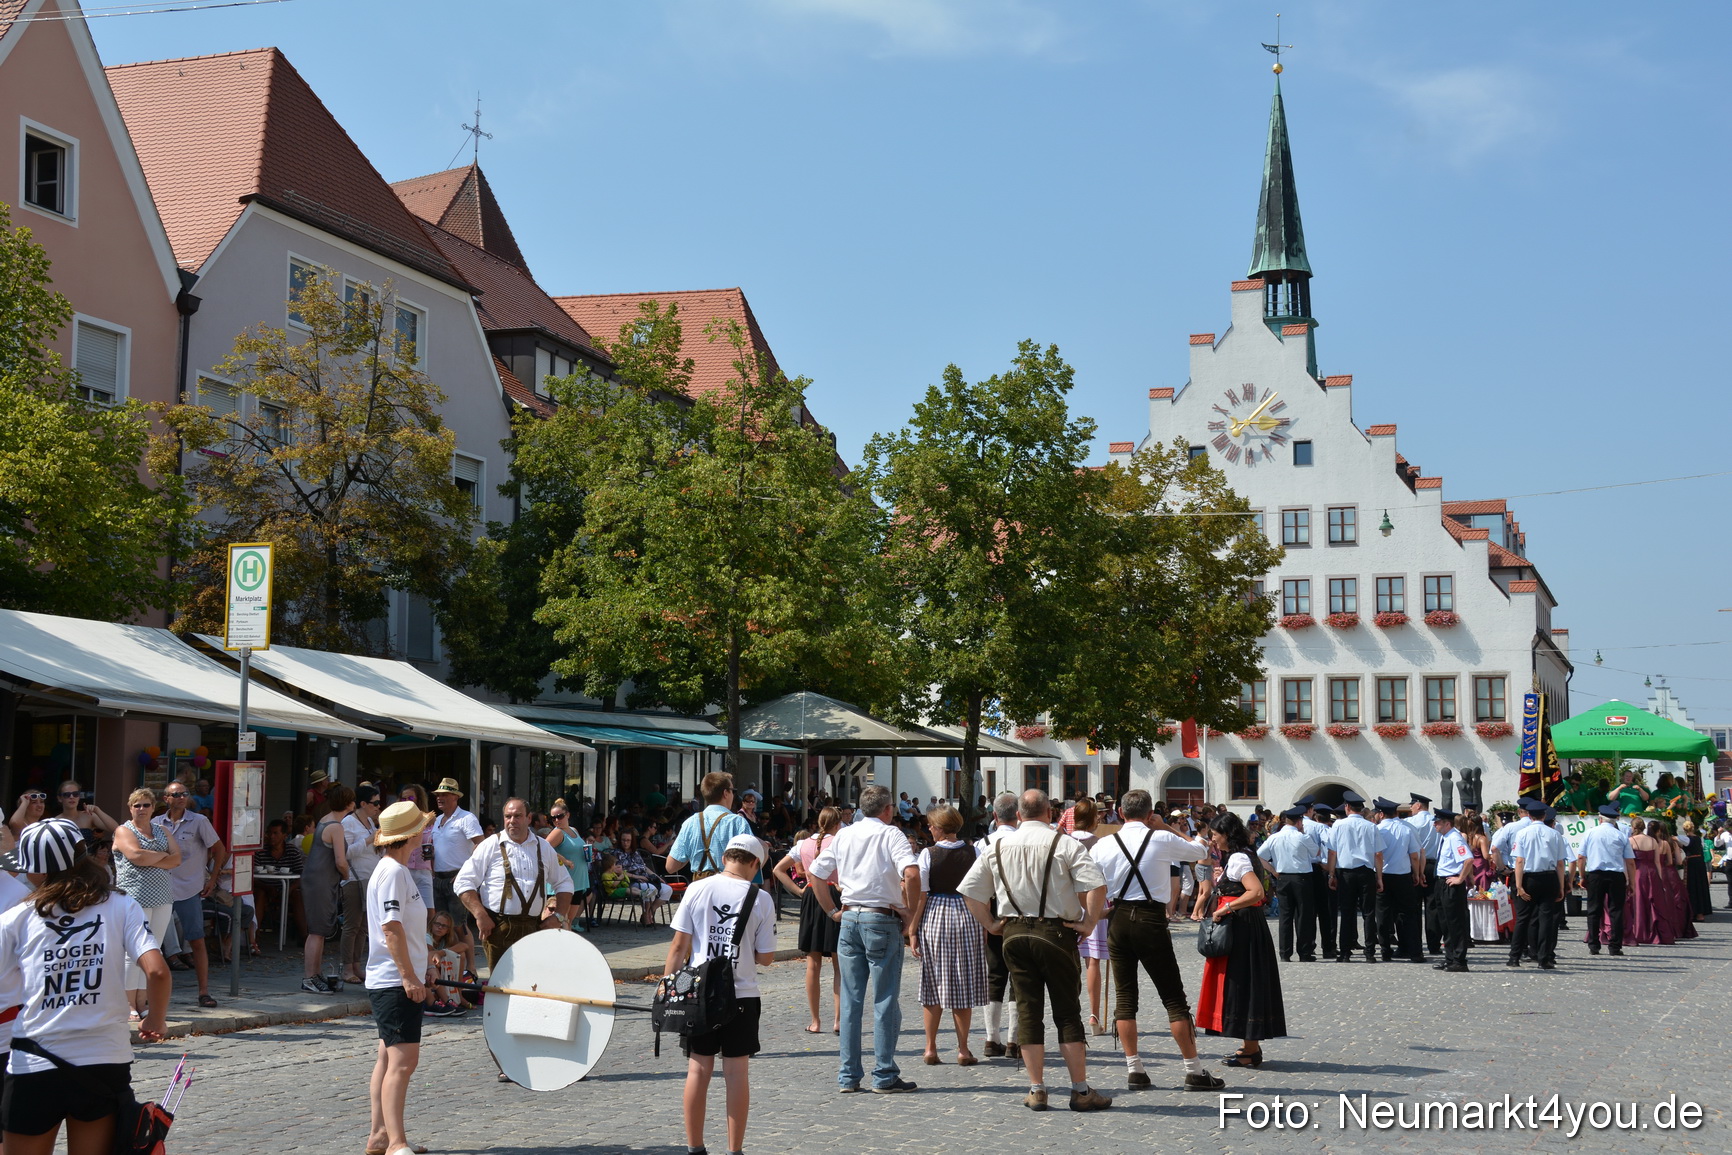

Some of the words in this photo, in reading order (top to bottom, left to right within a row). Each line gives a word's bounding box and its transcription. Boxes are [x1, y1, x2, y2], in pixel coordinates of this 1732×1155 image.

[242, 559, 258, 582] H
[1567, 821, 1586, 836] 50
[43, 942, 104, 962] BOGEN
[44, 957, 103, 973] SCHÜTZEN
[43, 968, 103, 997] NEU
[41, 992, 101, 1010] MARKT
